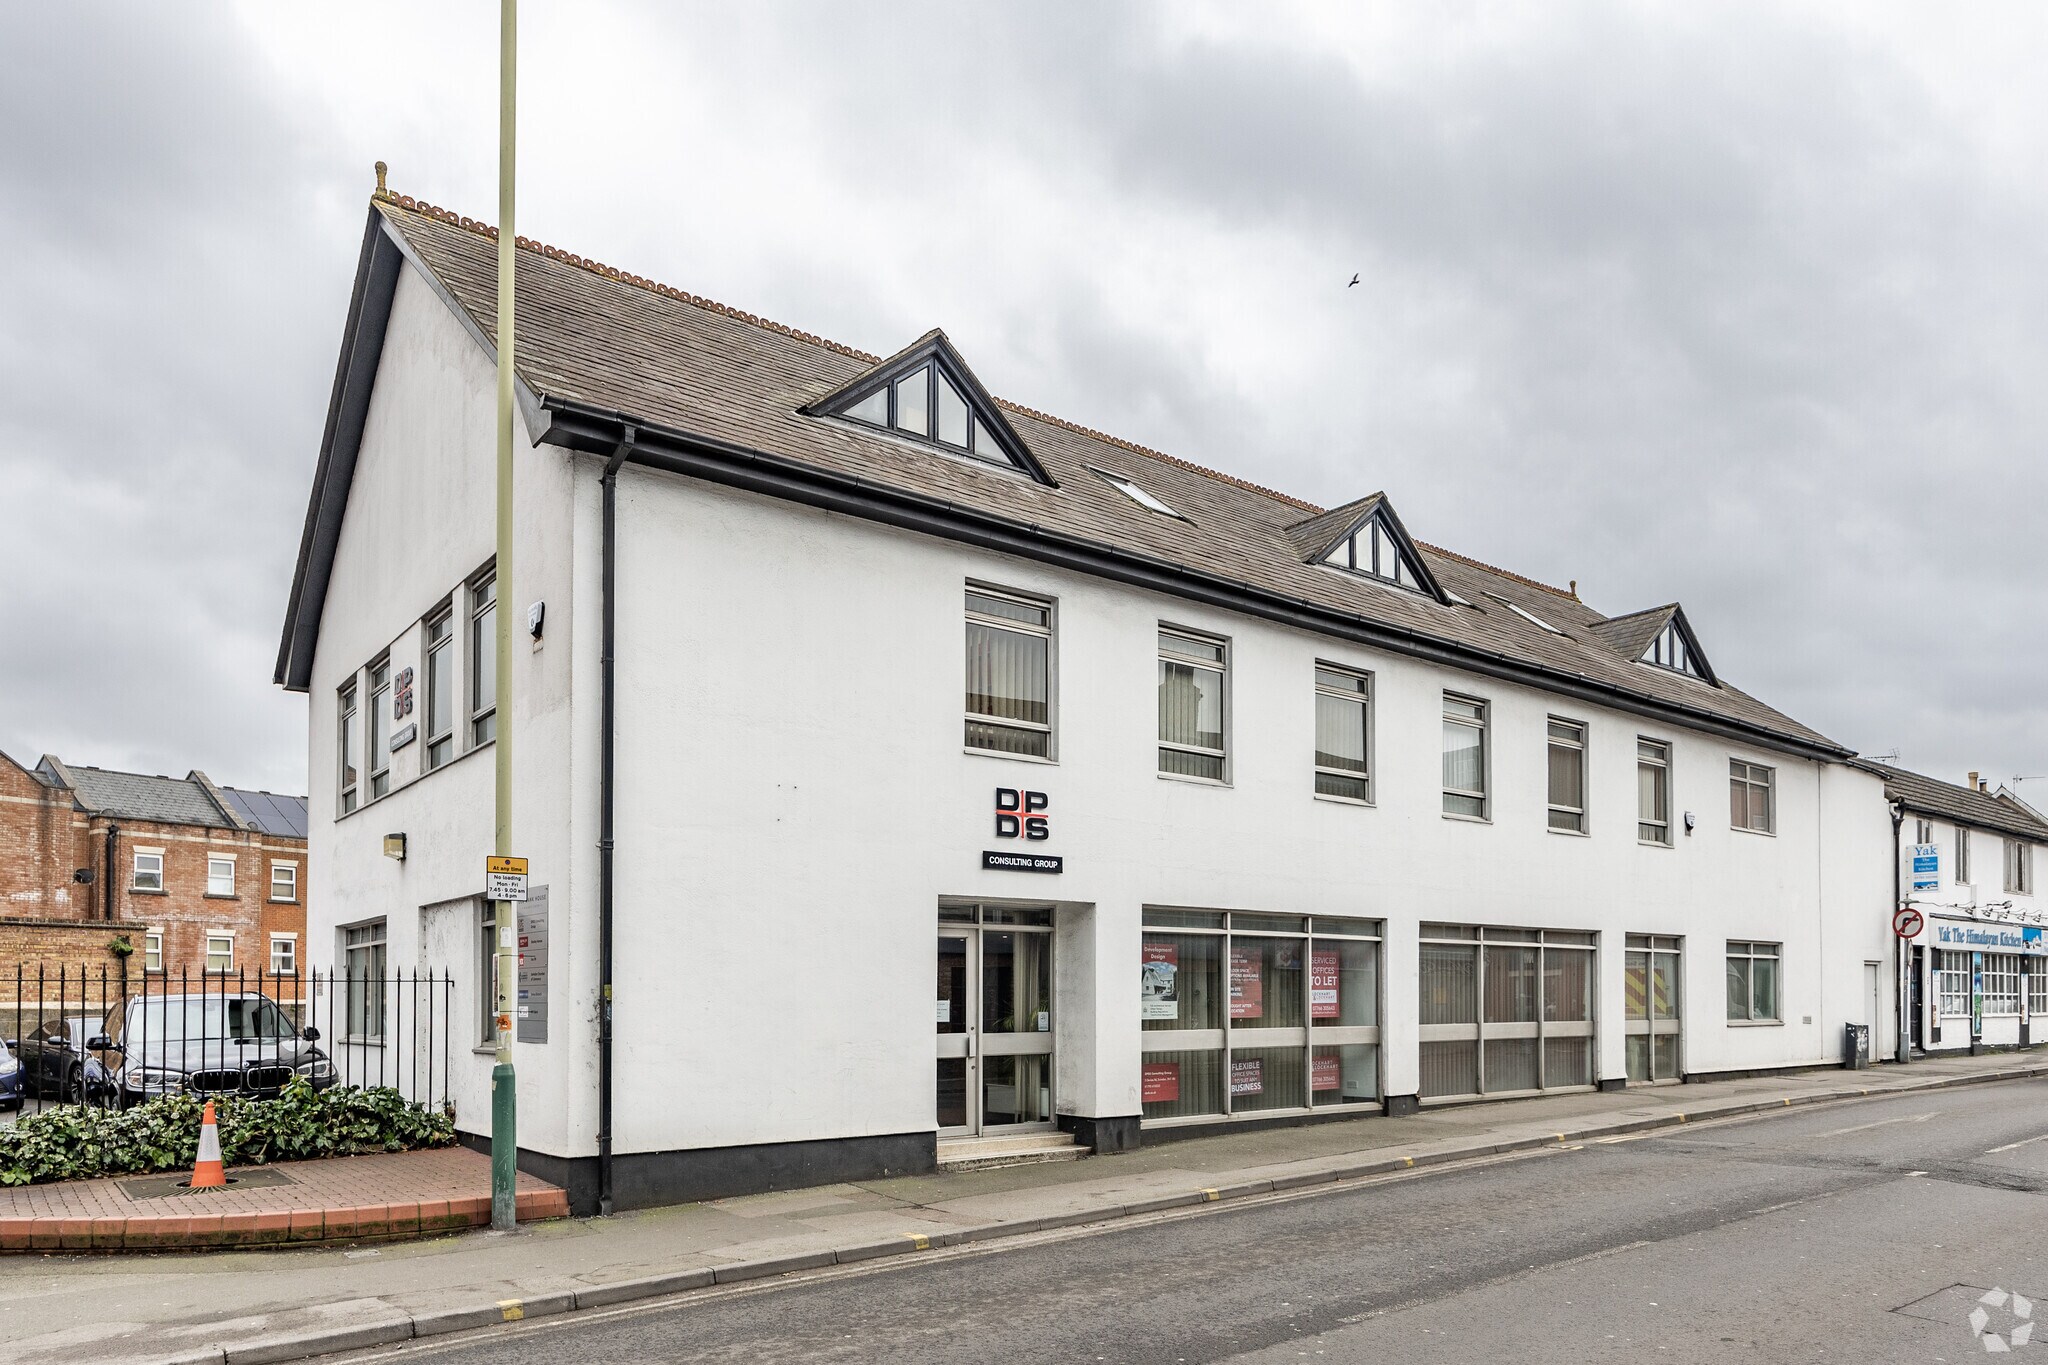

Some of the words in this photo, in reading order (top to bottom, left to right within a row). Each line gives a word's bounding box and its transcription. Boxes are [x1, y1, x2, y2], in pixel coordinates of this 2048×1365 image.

[1915, 846, 1936, 856] Yak
[989, 856, 1032, 867] CONSULTING
[1034, 860, 1058, 870] GROUP
[1938, 926, 1951, 942] Yak
[1952, 927, 1965, 943] The
[1966, 929, 1998, 950] Himalayan
[2000, 932, 2022, 948] Kitchen
[1312, 976, 1321, 986] TO
[1323, 976, 1337, 986] LET
[1232, 1061, 1260, 1070] FLEXIBLE
[1232, 1082, 1261, 1092] BUSINESS
